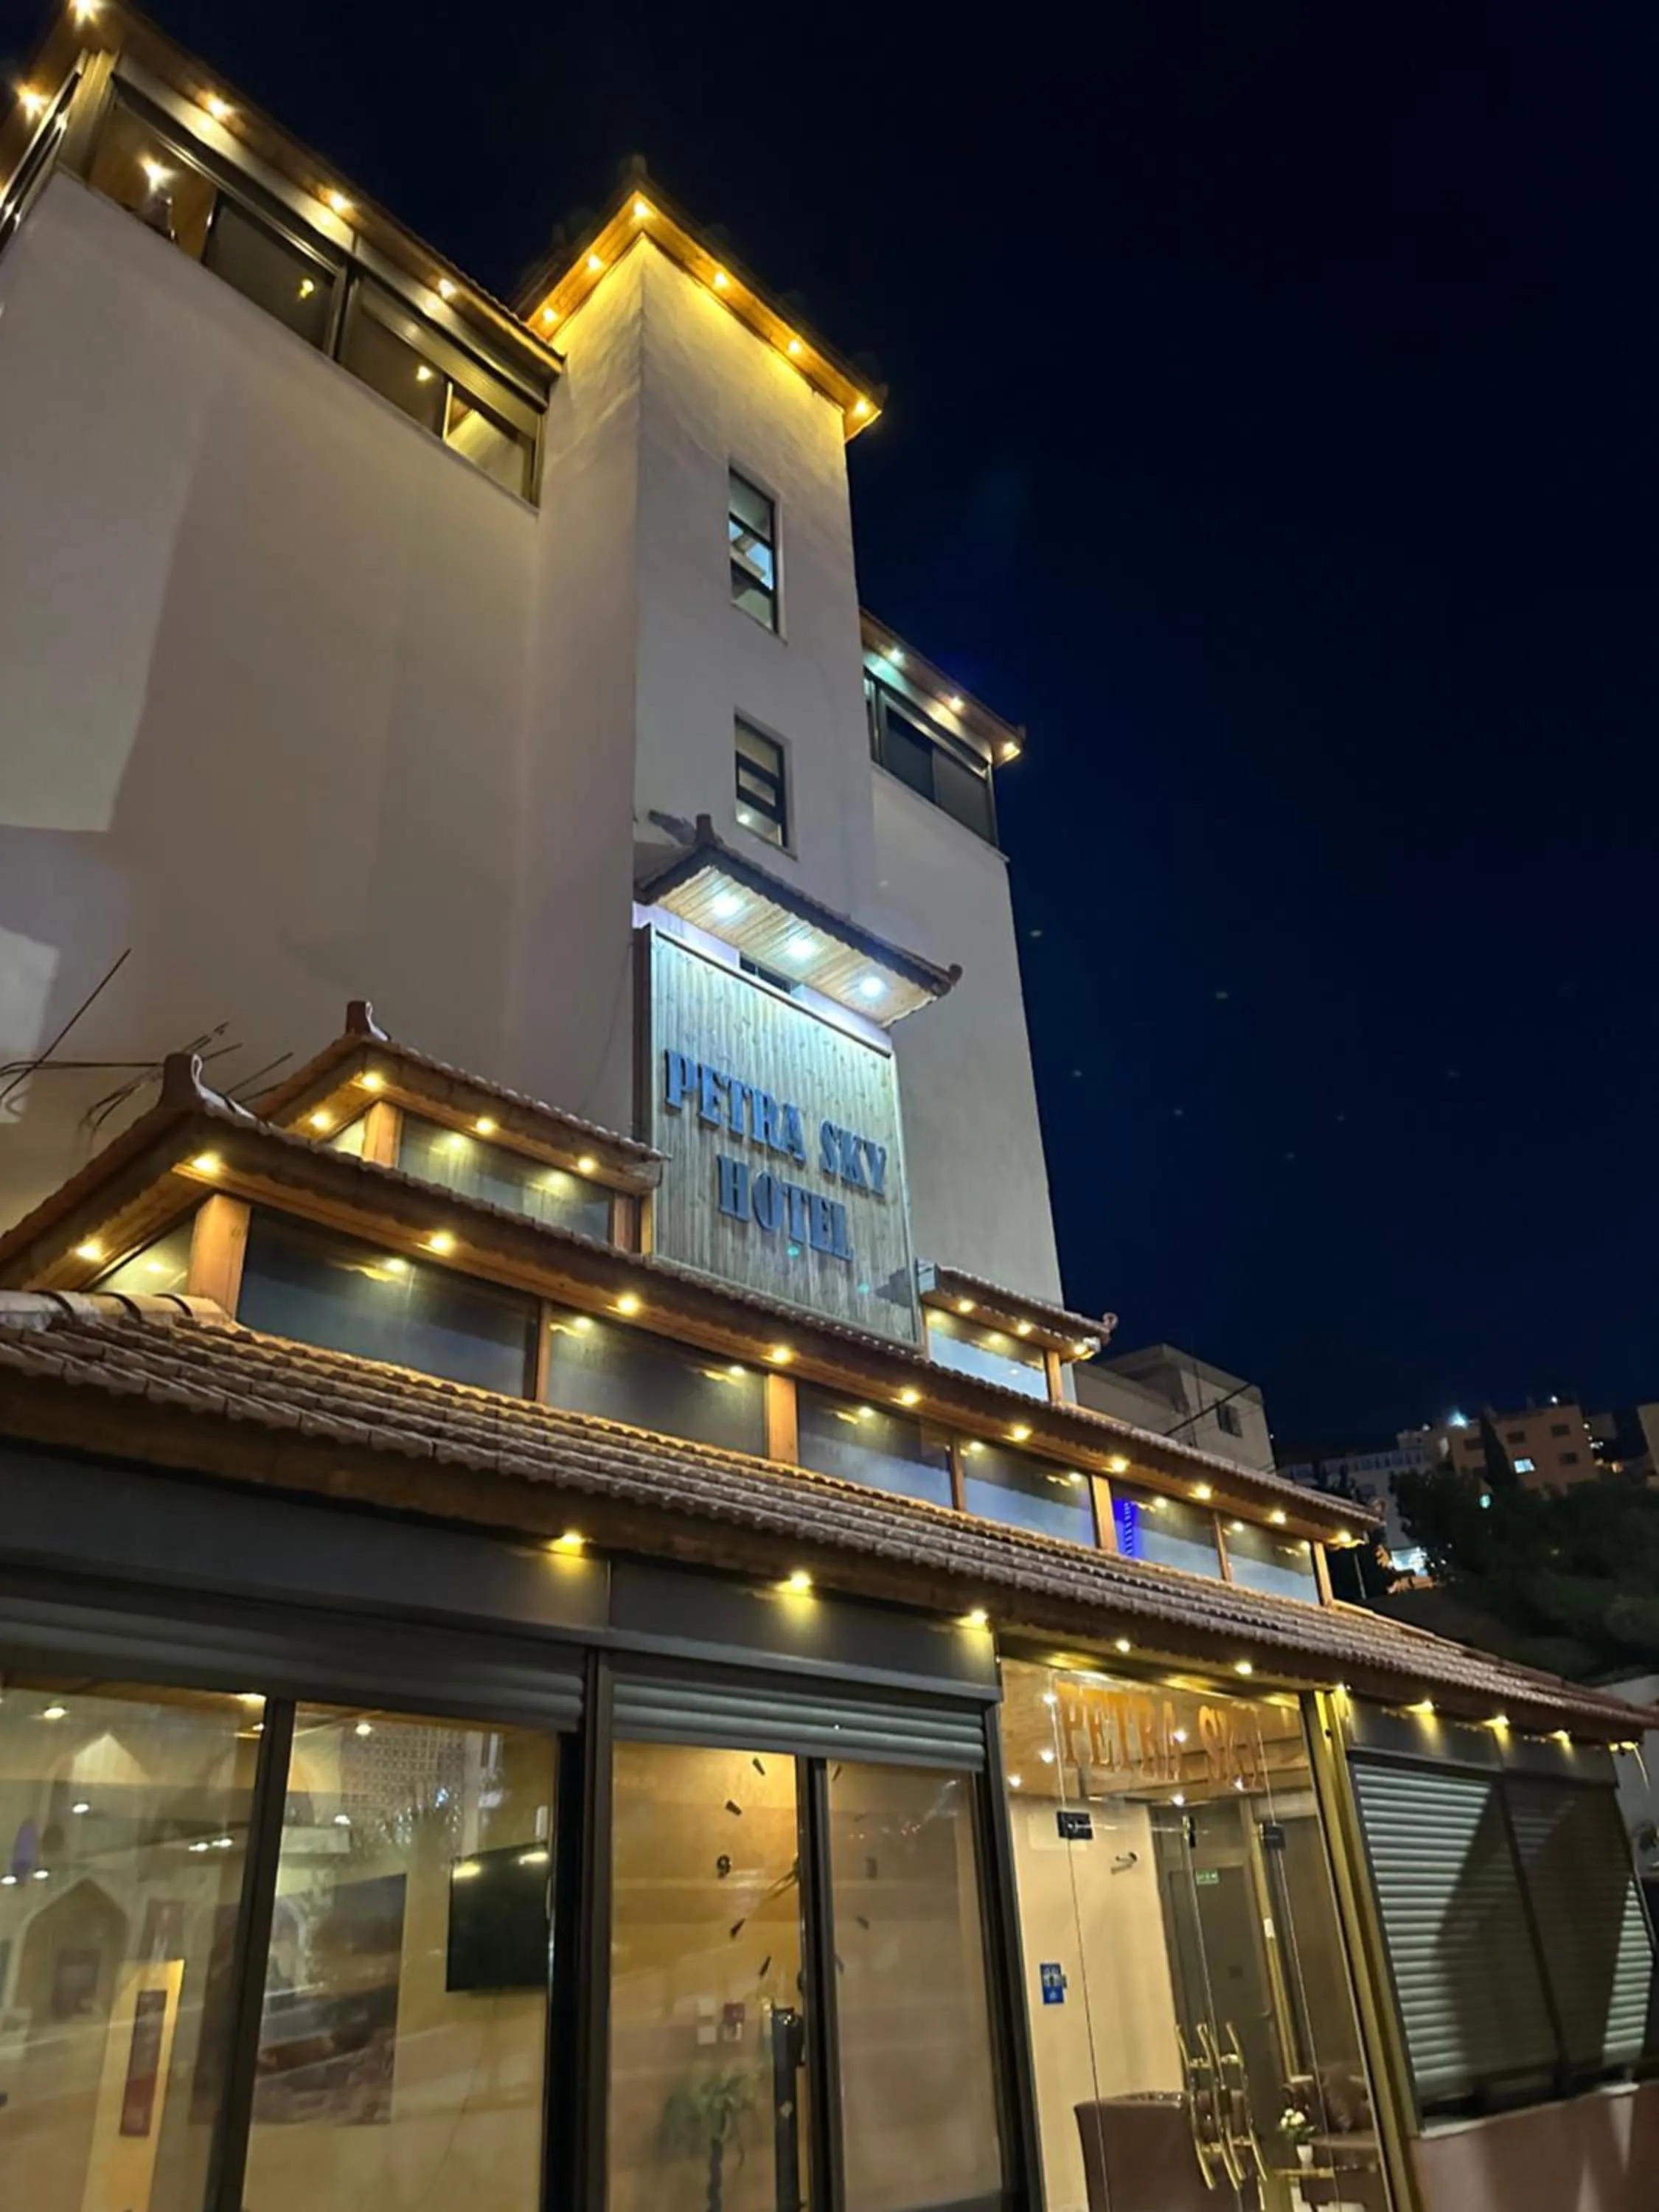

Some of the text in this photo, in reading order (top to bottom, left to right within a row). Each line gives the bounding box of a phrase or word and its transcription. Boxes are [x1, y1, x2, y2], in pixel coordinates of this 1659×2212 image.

[665, 1050, 886, 1196] PETRA SKY
[717, 1155, 852, 1262] HOTEL
